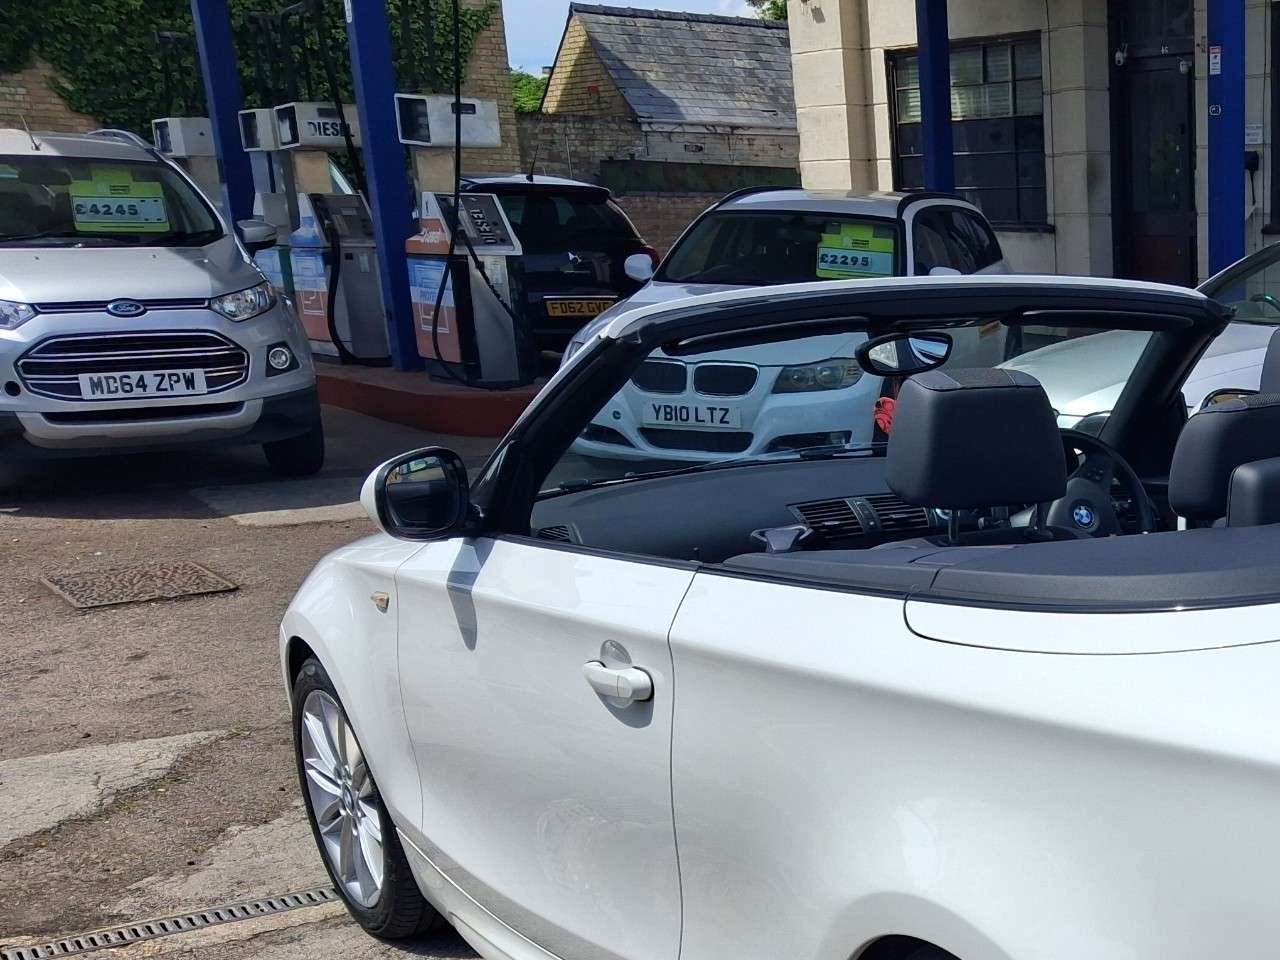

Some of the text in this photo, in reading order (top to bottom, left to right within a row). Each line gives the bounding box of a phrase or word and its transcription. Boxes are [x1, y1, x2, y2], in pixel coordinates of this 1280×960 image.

[75, 203, 138, 216] £4245
[820, 253, 870, 267] £2295
[550, 302, 585, 314] FD62
[153, 372, 196, 392] ZPW
[652, 403, 730, 424] YB10 LTZ
